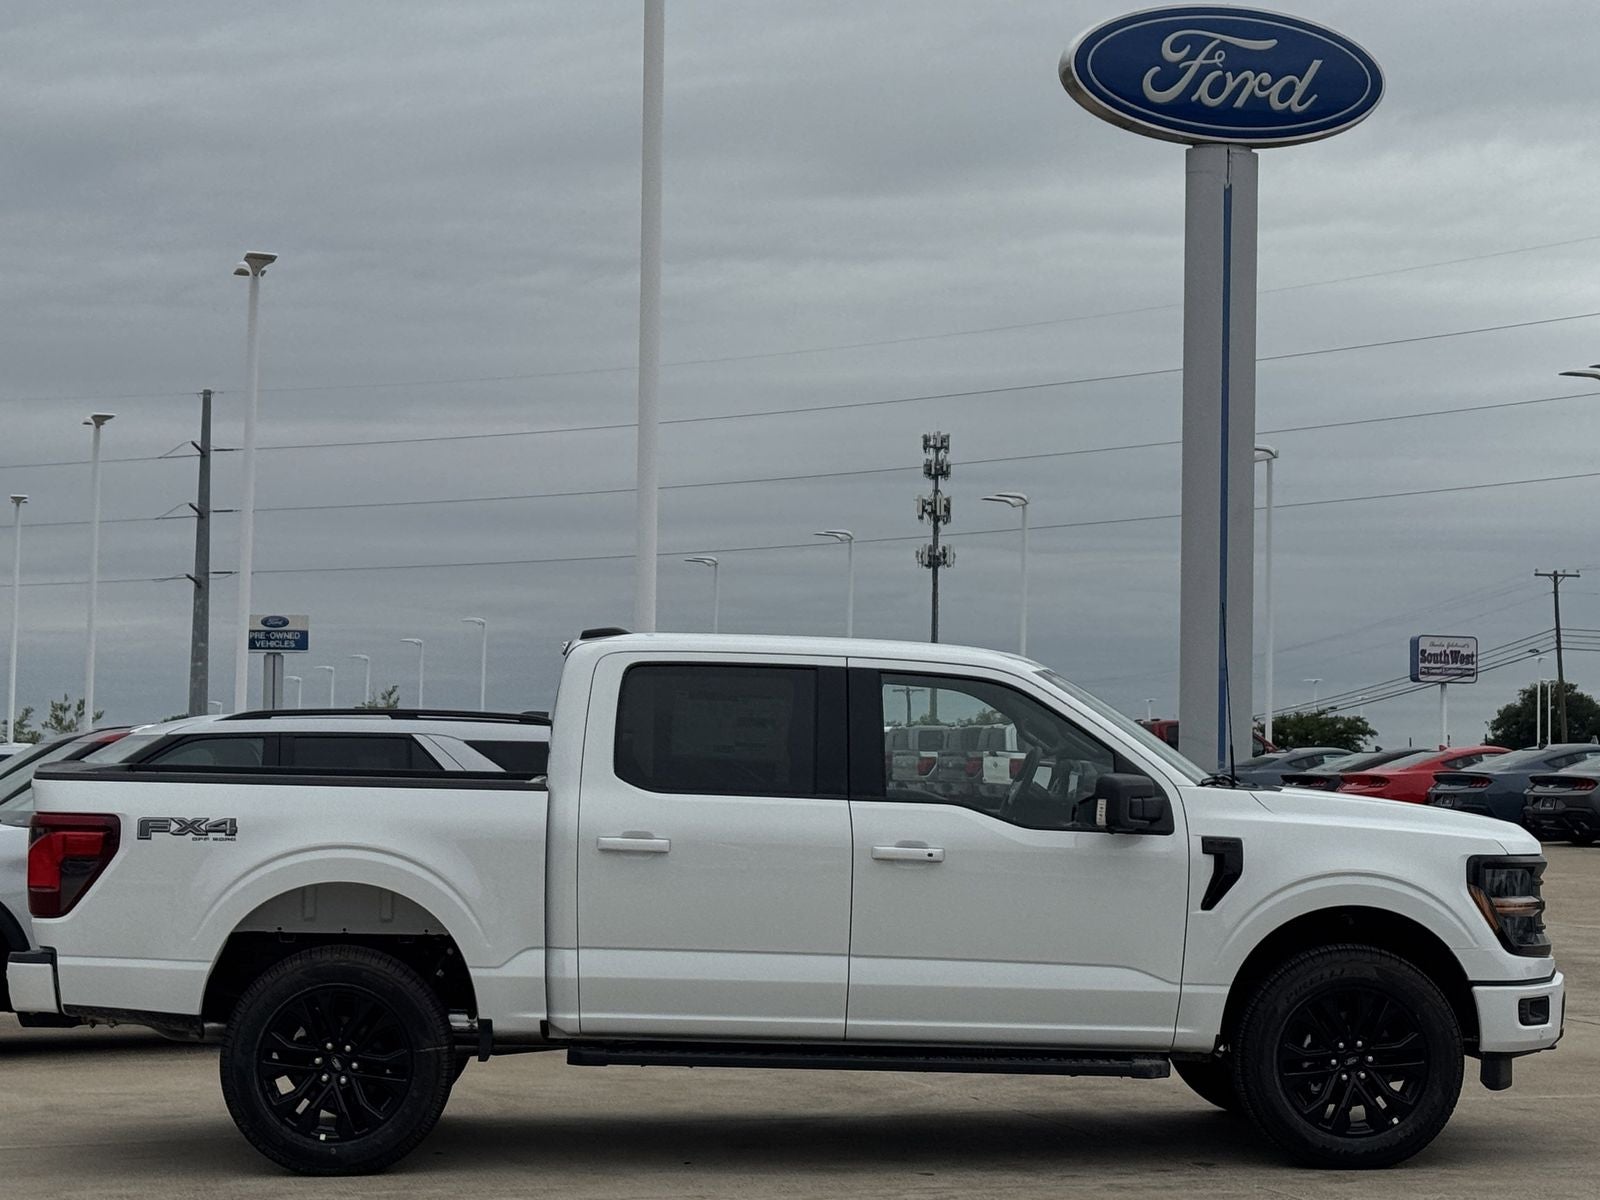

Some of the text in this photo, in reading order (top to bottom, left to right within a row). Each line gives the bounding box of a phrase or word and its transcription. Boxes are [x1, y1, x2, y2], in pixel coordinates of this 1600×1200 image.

[1142, 29, 1323, 113] Ford
[249, 631, 301, 639] PRE-OWNED
[255, 640, 296, 648] VEHICLES
[1420, 649, 1475, 665] SouthWest
[137, 817, 238, 840] FX4
